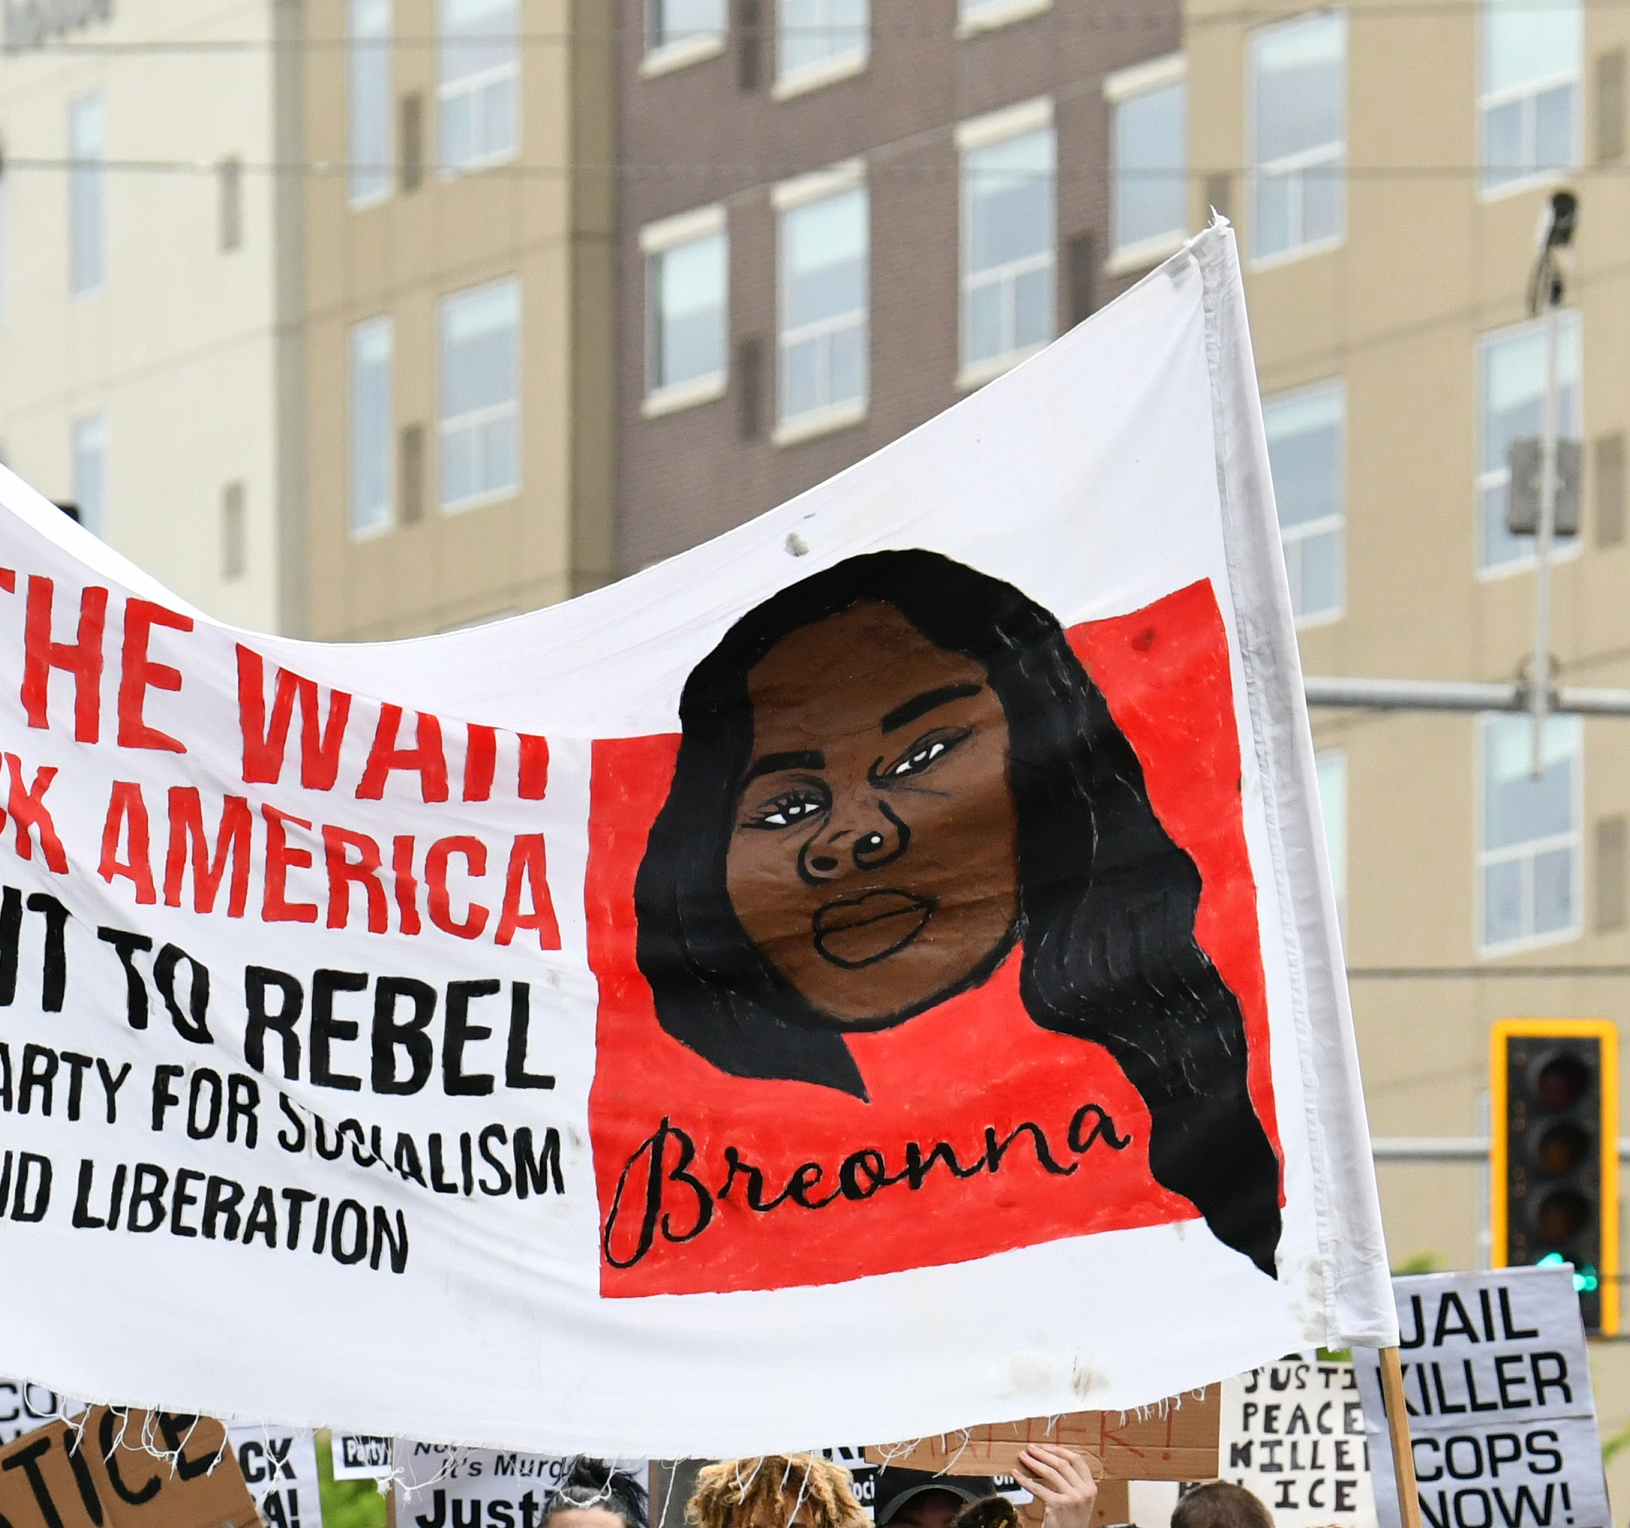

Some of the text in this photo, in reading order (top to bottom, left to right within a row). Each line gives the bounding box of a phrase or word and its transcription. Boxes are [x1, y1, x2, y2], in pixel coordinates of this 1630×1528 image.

[97, 781, 561, 951] AMERICA
[97, 927, 214, 1043] TO
[244, 965, 556, 1098] REBEL
[151, 1064, 261, 1149] FOR
[72, 1159, 409, 1274] LIBERATION
[605, 1102, 1132, 1270] Breonna
[1400, 1287, 1539, 1350] JAIL
[1242, 1401, 1365, 1435] PEACE
[1376, 1351, 1574, 1418] KILLER
[1230, 1438, 1371, 1473] KILLE
[1411, 1430, 1563, 1482] COPS
